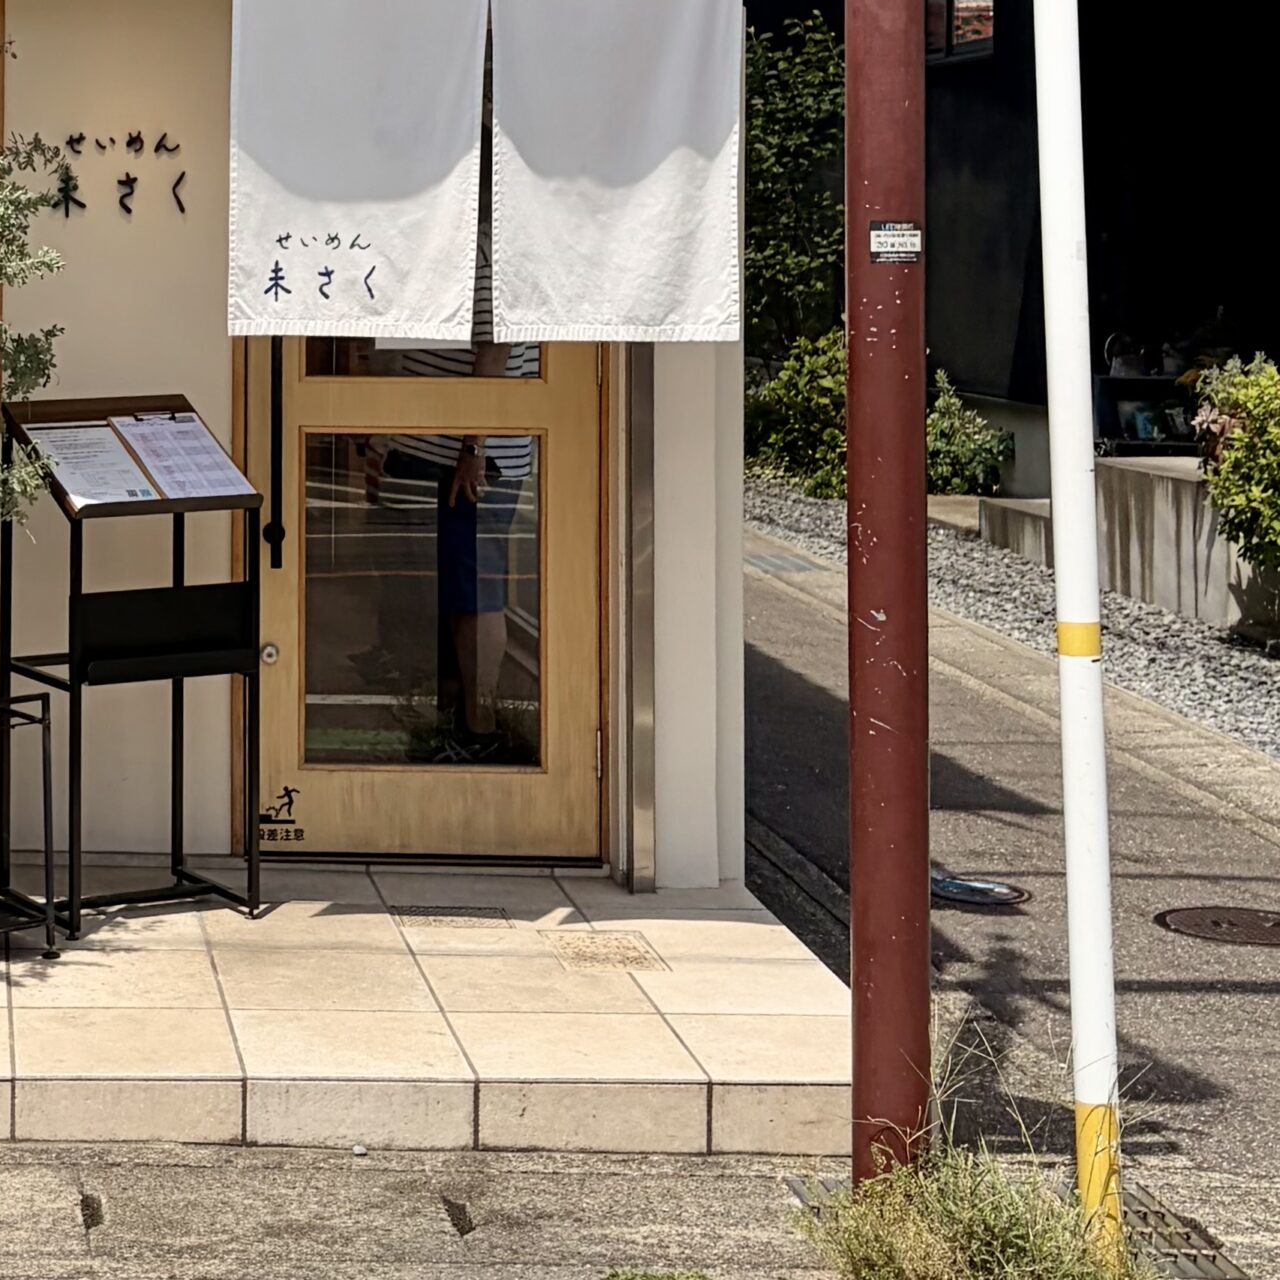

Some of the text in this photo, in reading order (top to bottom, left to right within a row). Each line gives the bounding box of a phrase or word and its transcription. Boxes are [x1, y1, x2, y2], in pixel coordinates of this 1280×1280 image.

[65, 130, 181, 154] せいめん
[275, 231, 372, 250] せいめん
